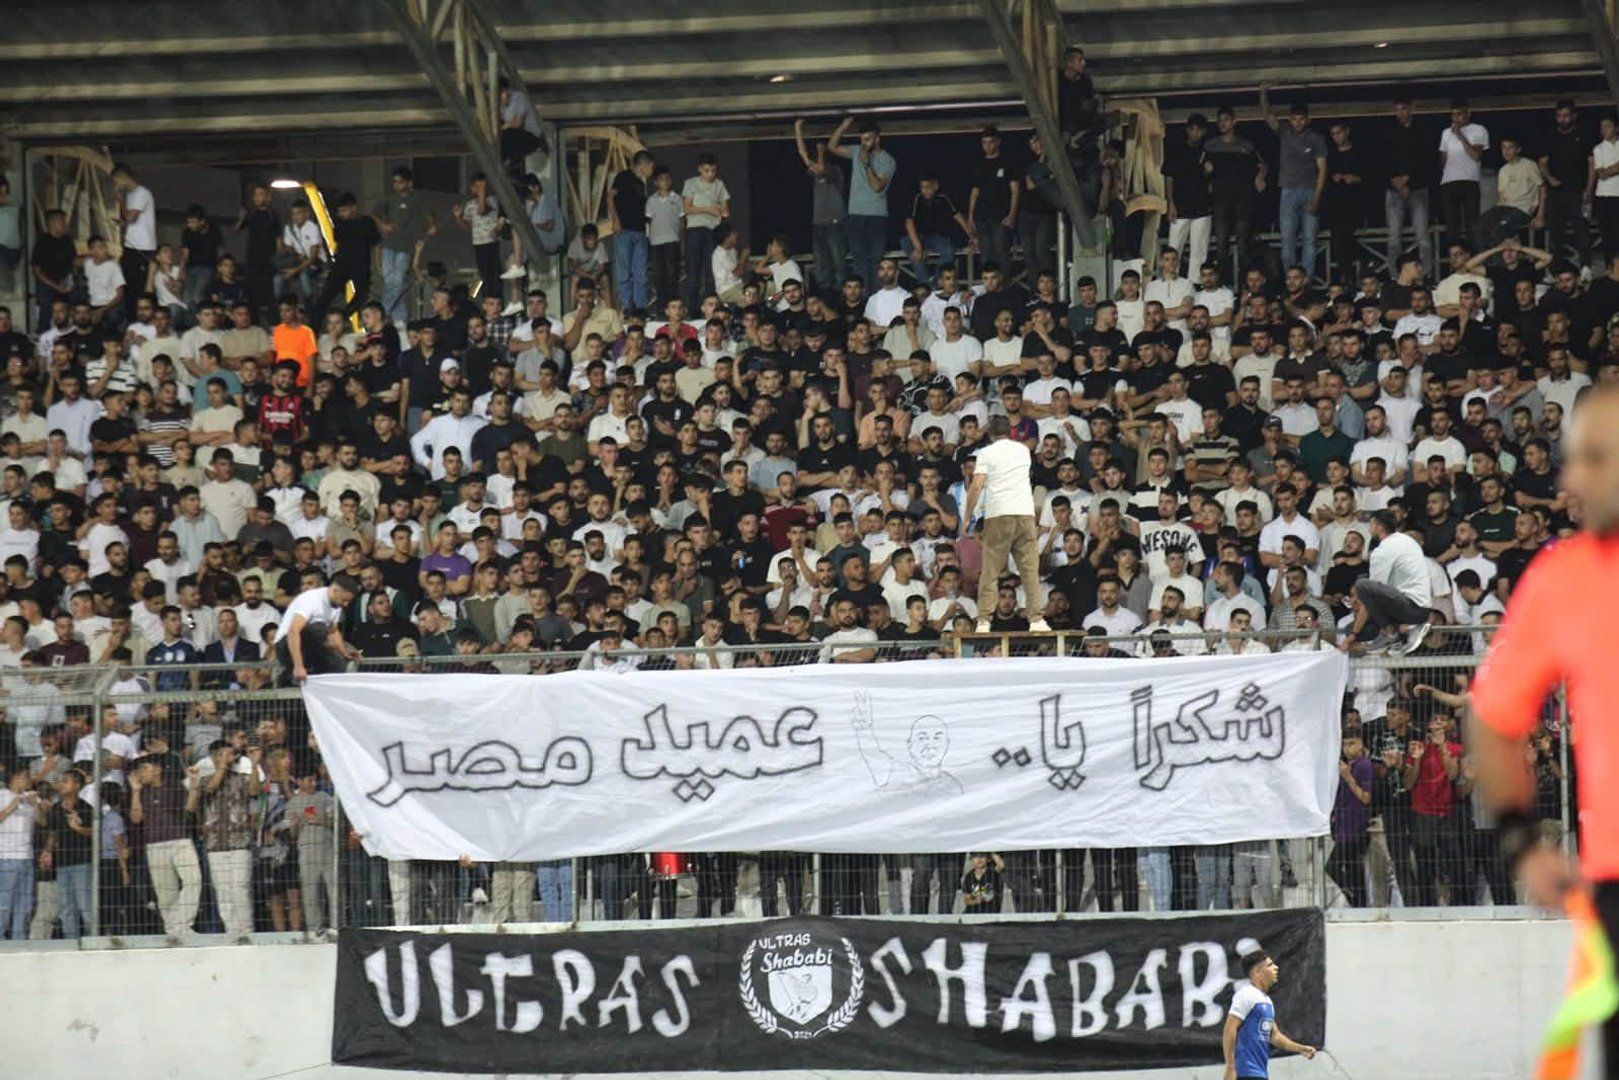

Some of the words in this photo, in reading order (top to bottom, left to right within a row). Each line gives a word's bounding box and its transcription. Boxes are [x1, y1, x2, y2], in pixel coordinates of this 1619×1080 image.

[366, 735, 593, 808] مصر
[620, 703, 824, 803] عميد
[1130, 683, 1285, 792] شكراً
[758, 933, 811, 949] ULTRAS
[760, 948, 833, 973] Shababi
[364, 940, 701, 1038] ULTRAS
